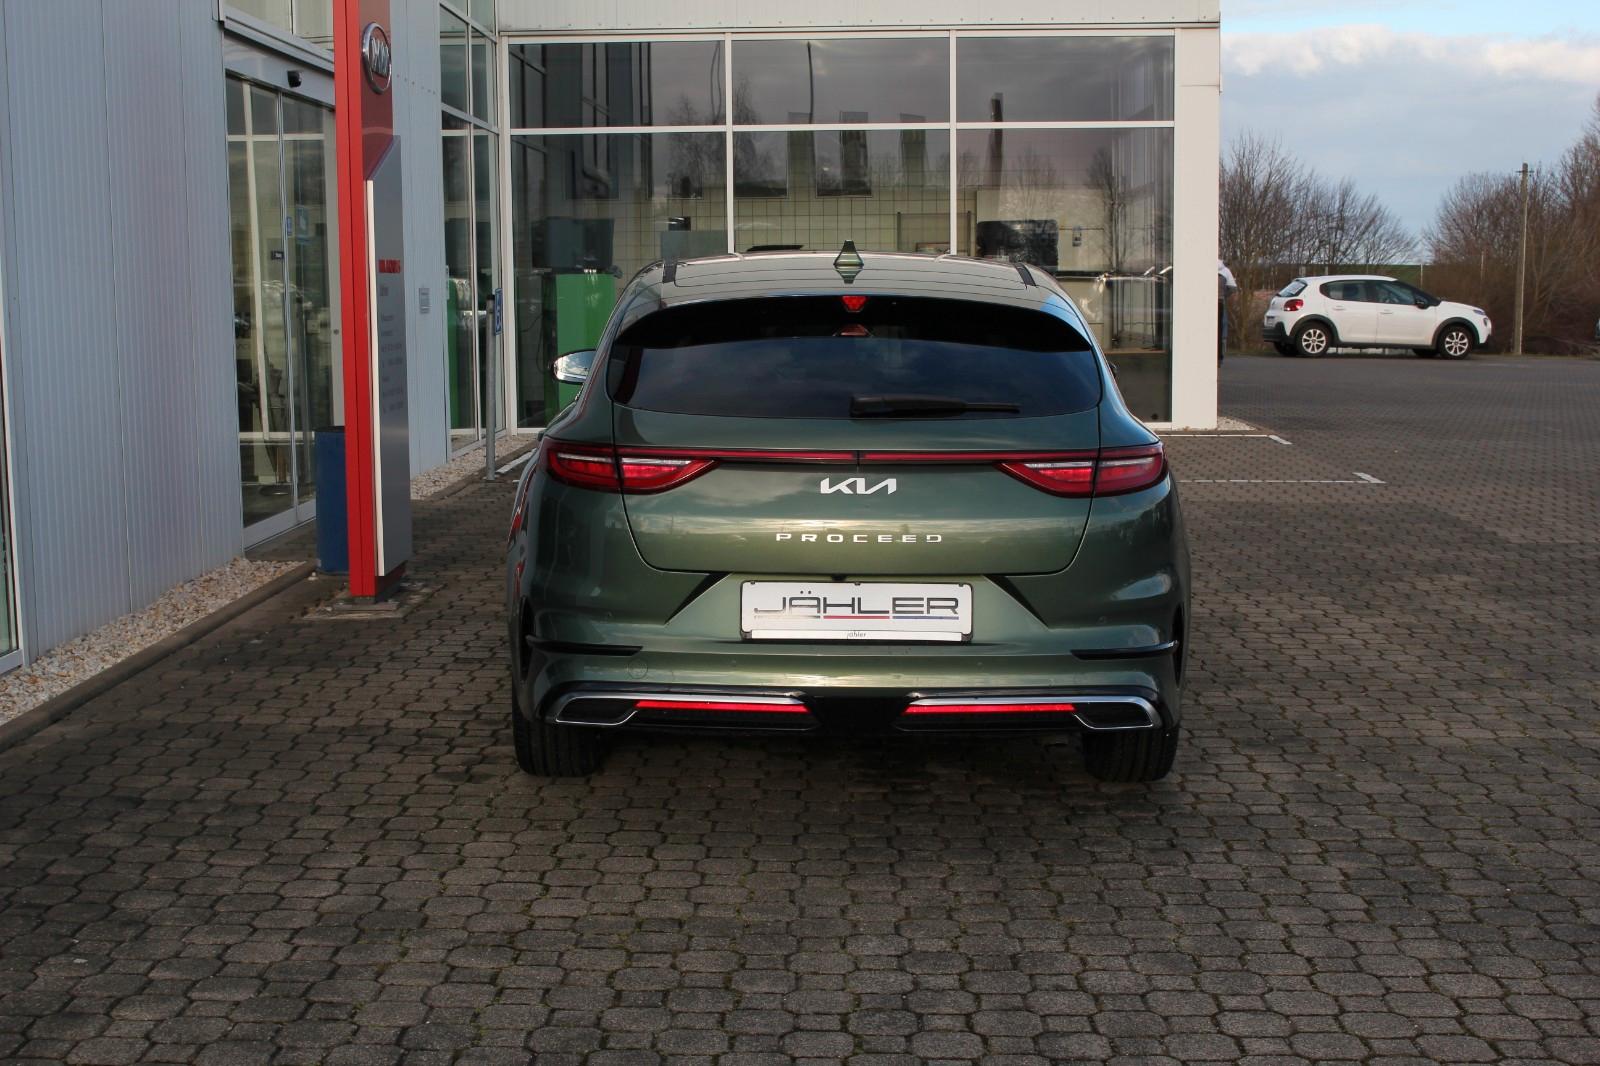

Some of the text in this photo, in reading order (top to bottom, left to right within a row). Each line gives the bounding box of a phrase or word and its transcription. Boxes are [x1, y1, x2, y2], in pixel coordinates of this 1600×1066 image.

[820, 477, 897, 494] KIA
[775, 532, 943, 543] PROCEED
[754, 590, 959, 615] JÄHLER
